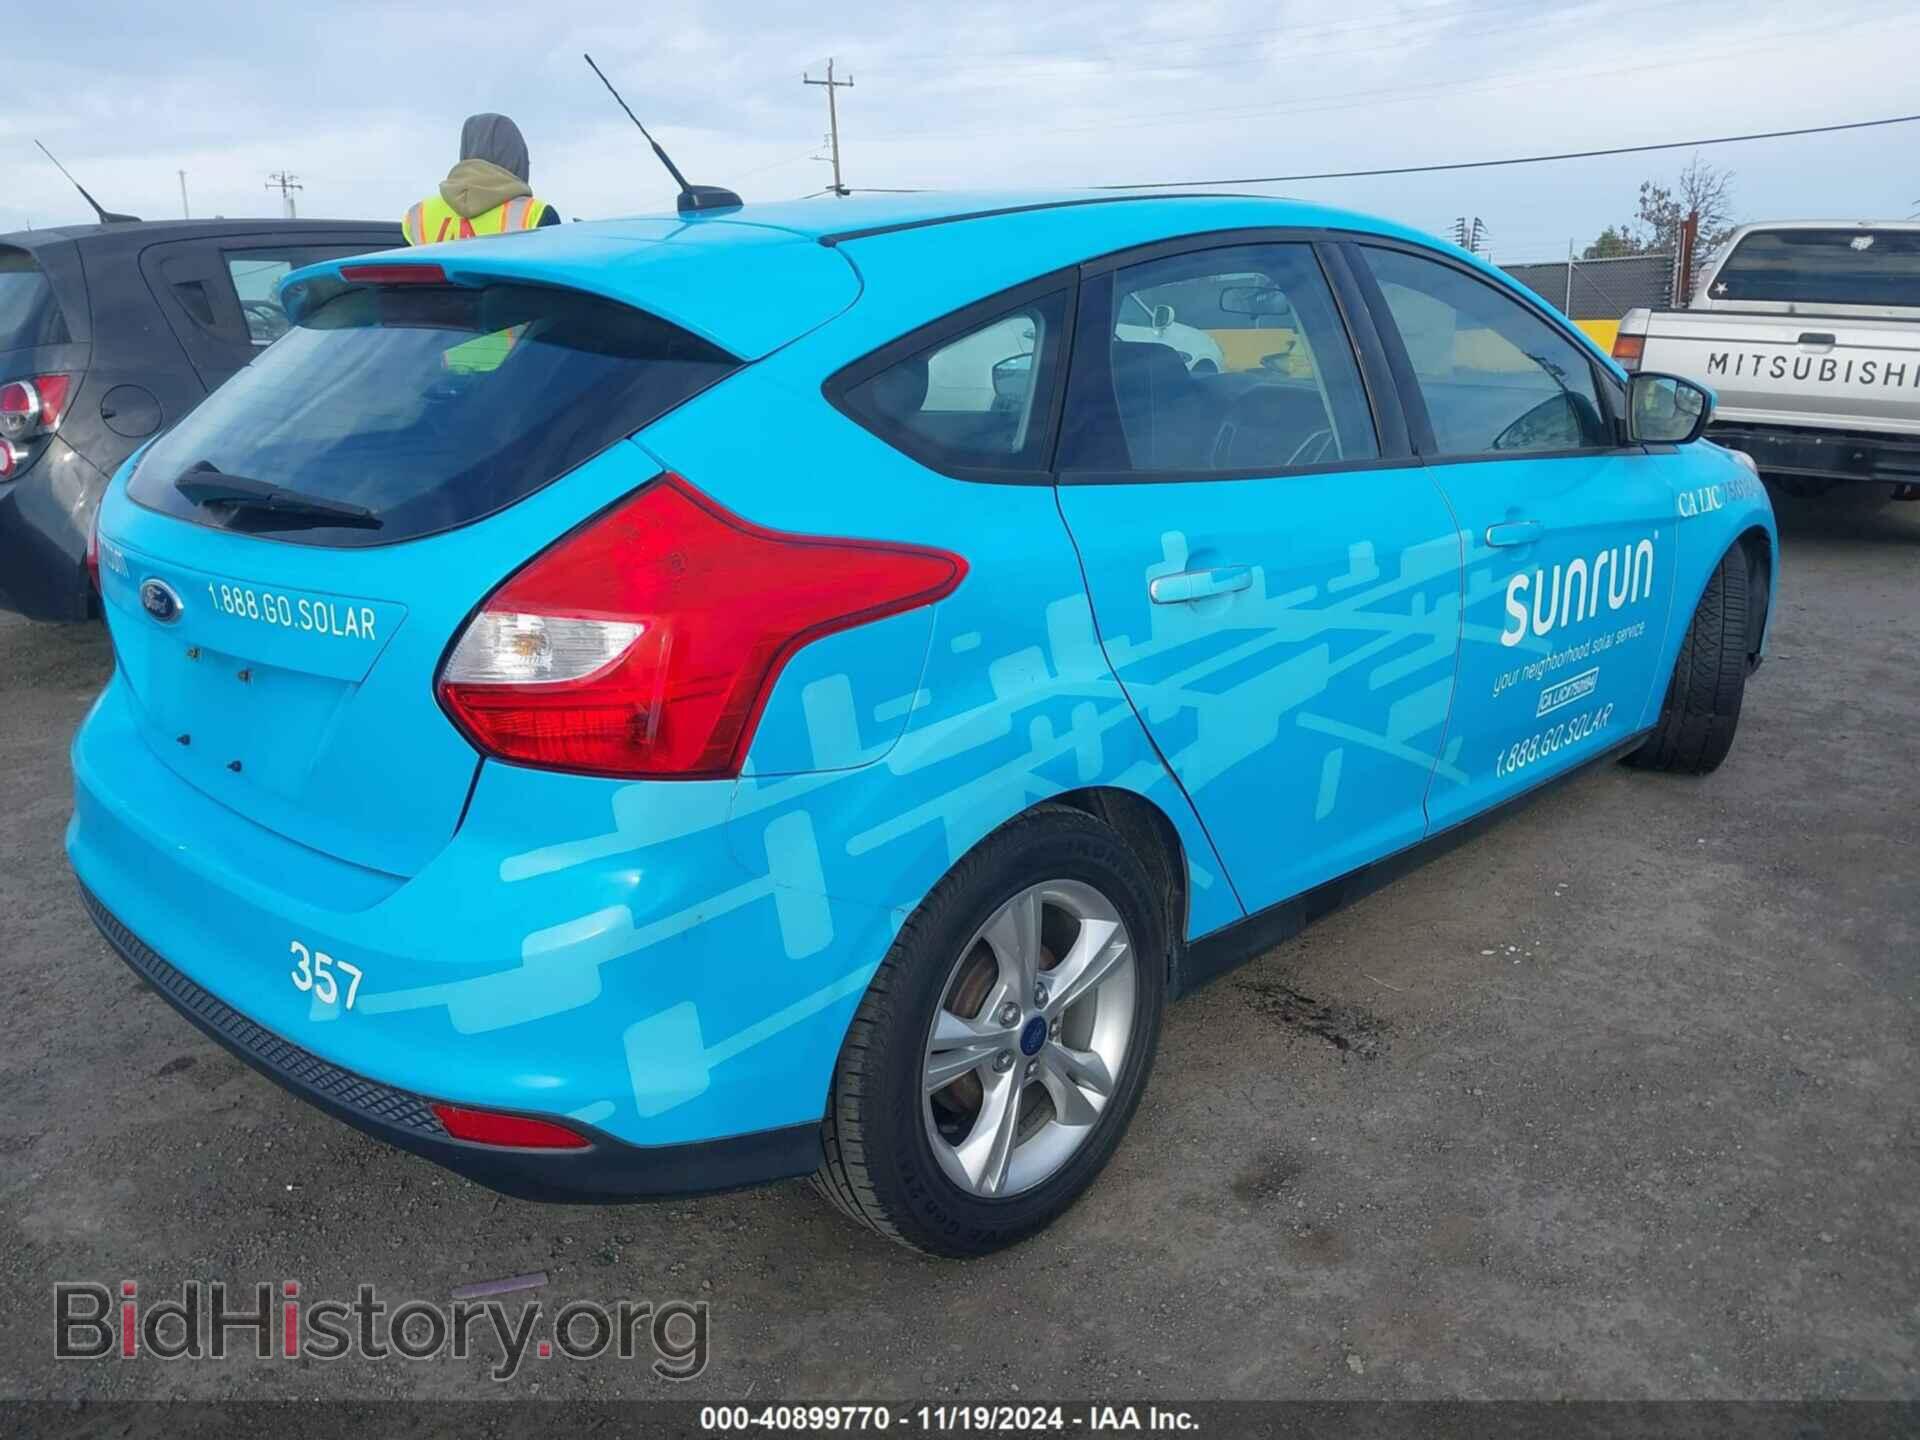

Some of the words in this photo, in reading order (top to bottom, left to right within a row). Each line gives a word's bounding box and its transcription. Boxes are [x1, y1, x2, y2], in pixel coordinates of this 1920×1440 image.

[1707, 352, 1920, 388] MITSUBISHI
[1678, 490, 1698, 518] CA
[208, 582, 376, 641] 1.888.GO.SOLAR
[1500, 538, 1653, 647] sunrun
[1492, 668, 1520, 698] your
[1521, 637, 1591, 680] neighborhood
[1591, 631, 1615, 654] solar
[1615, 620, 1646, 644] service
[1495, 702, 1615, 778] 1.888.GO.SOLAR
[290, 939, 363, 1011] 357
